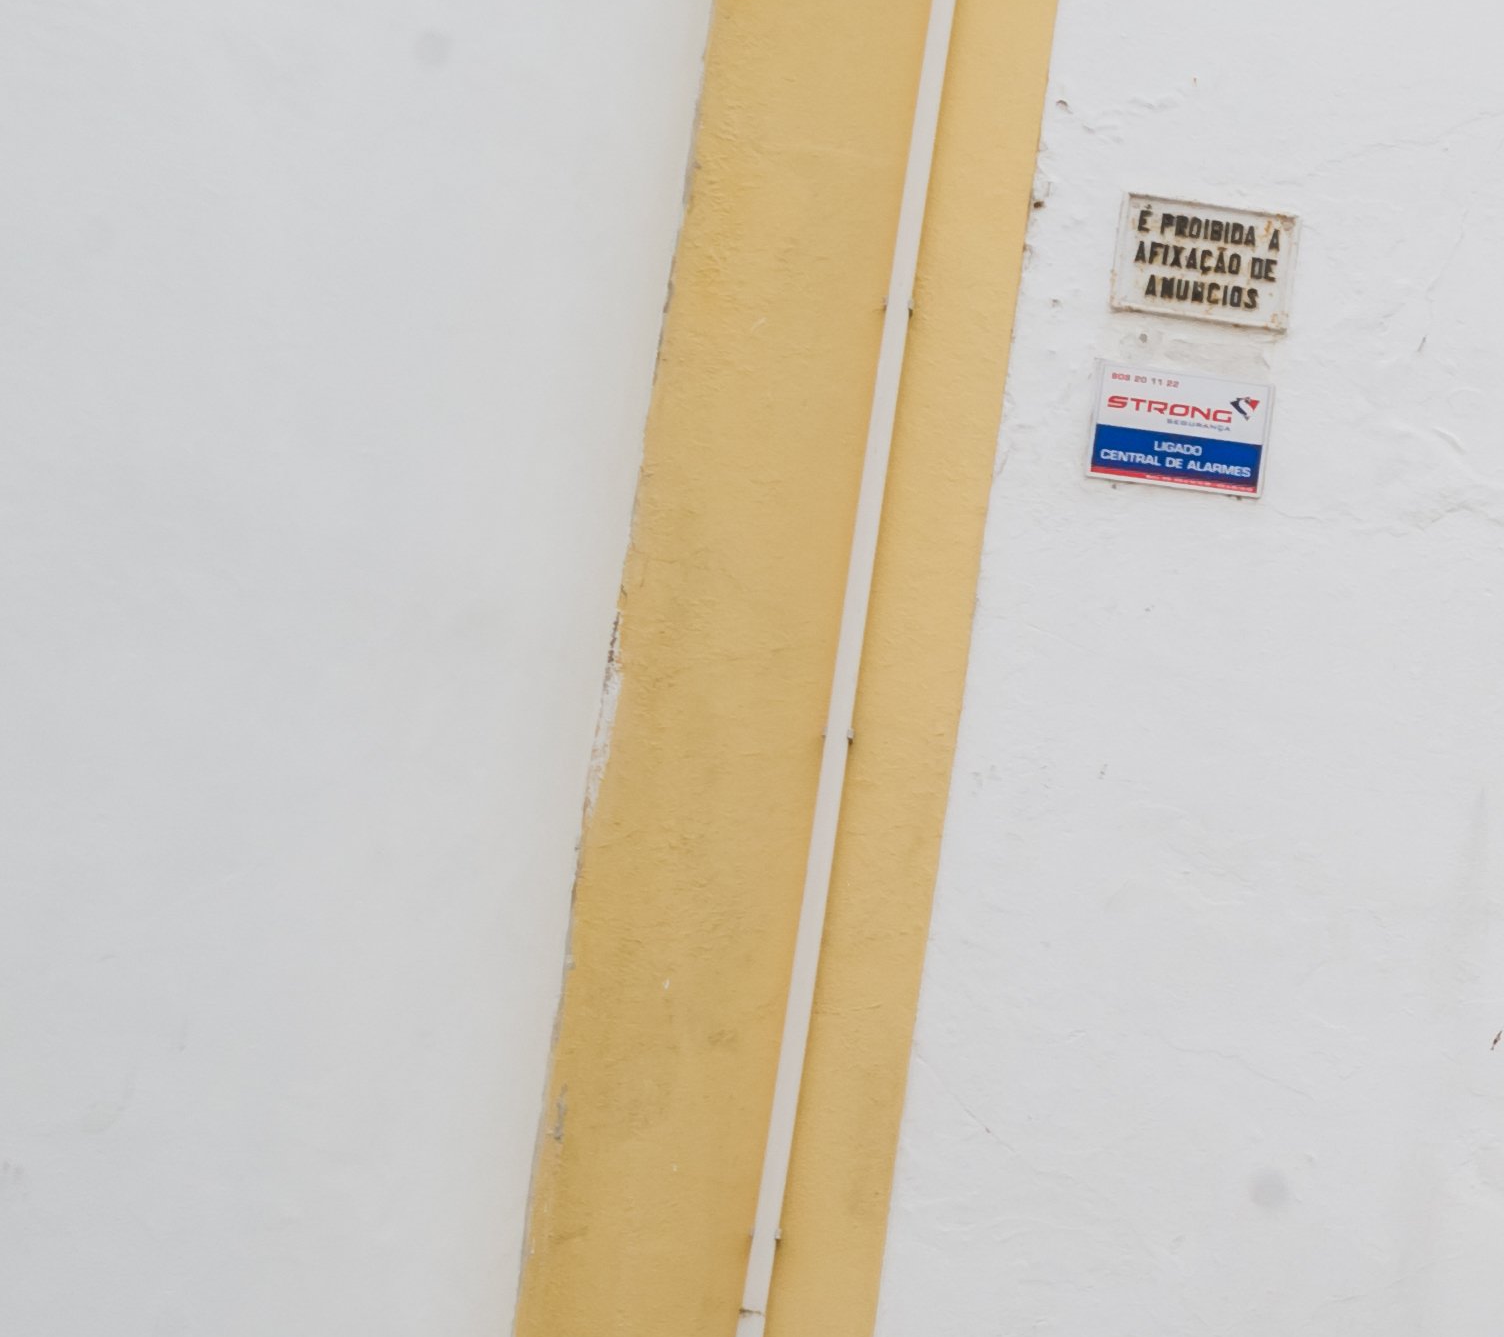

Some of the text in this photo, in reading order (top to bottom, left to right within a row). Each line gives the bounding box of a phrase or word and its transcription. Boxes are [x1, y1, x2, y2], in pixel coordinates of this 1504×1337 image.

[1138, 204, 1280, 251] É PROIBIDA A
[1134, 240, 1278, 283] AFIXAÇÃO DE
[1145, 274, 1258, 309] ANUNCIOS
[1107, 395, 1233, 424] STRONG
[1166, 418, 1231, 432] SEGURANÇA
[1100, 448, 1252, 478] CENTRAL DE ALARMES
[1153, 440, 1202, 457] LIGADO
